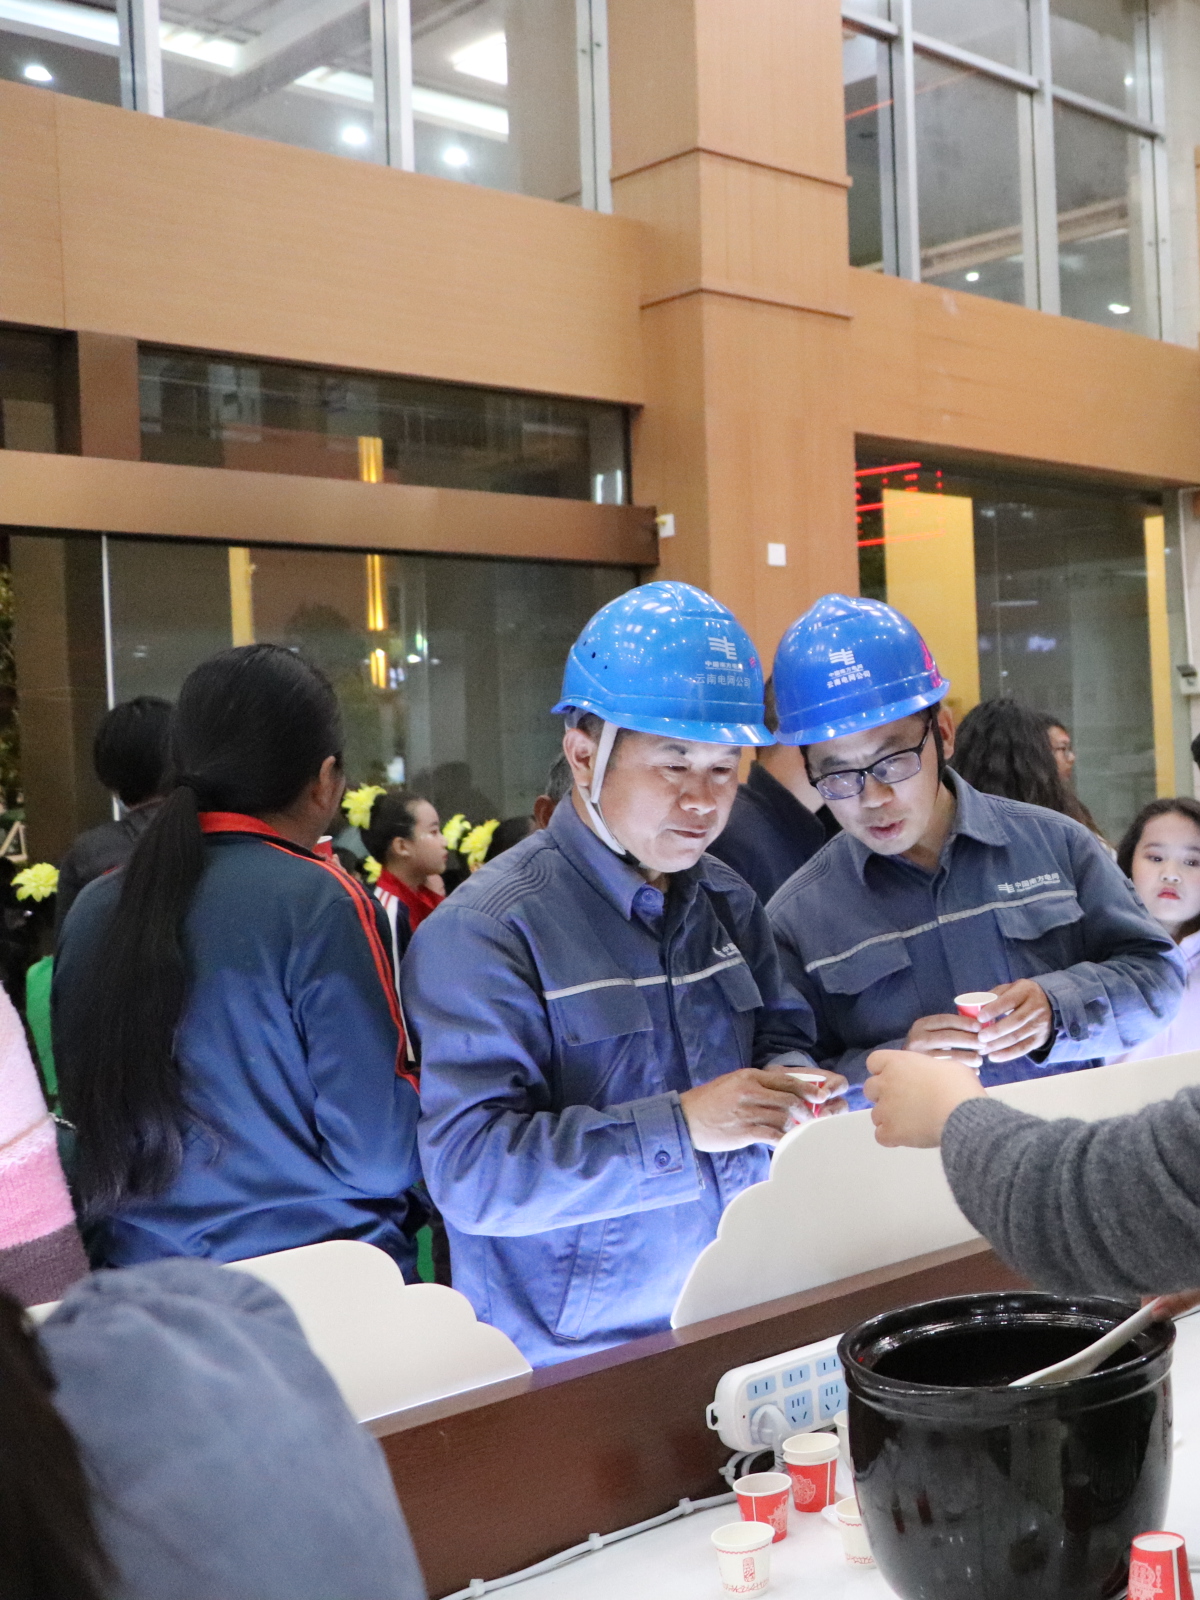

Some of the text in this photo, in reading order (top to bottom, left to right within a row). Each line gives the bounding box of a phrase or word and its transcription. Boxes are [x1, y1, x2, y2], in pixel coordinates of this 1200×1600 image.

[695, 673, 751, 689] 云南电网公司
